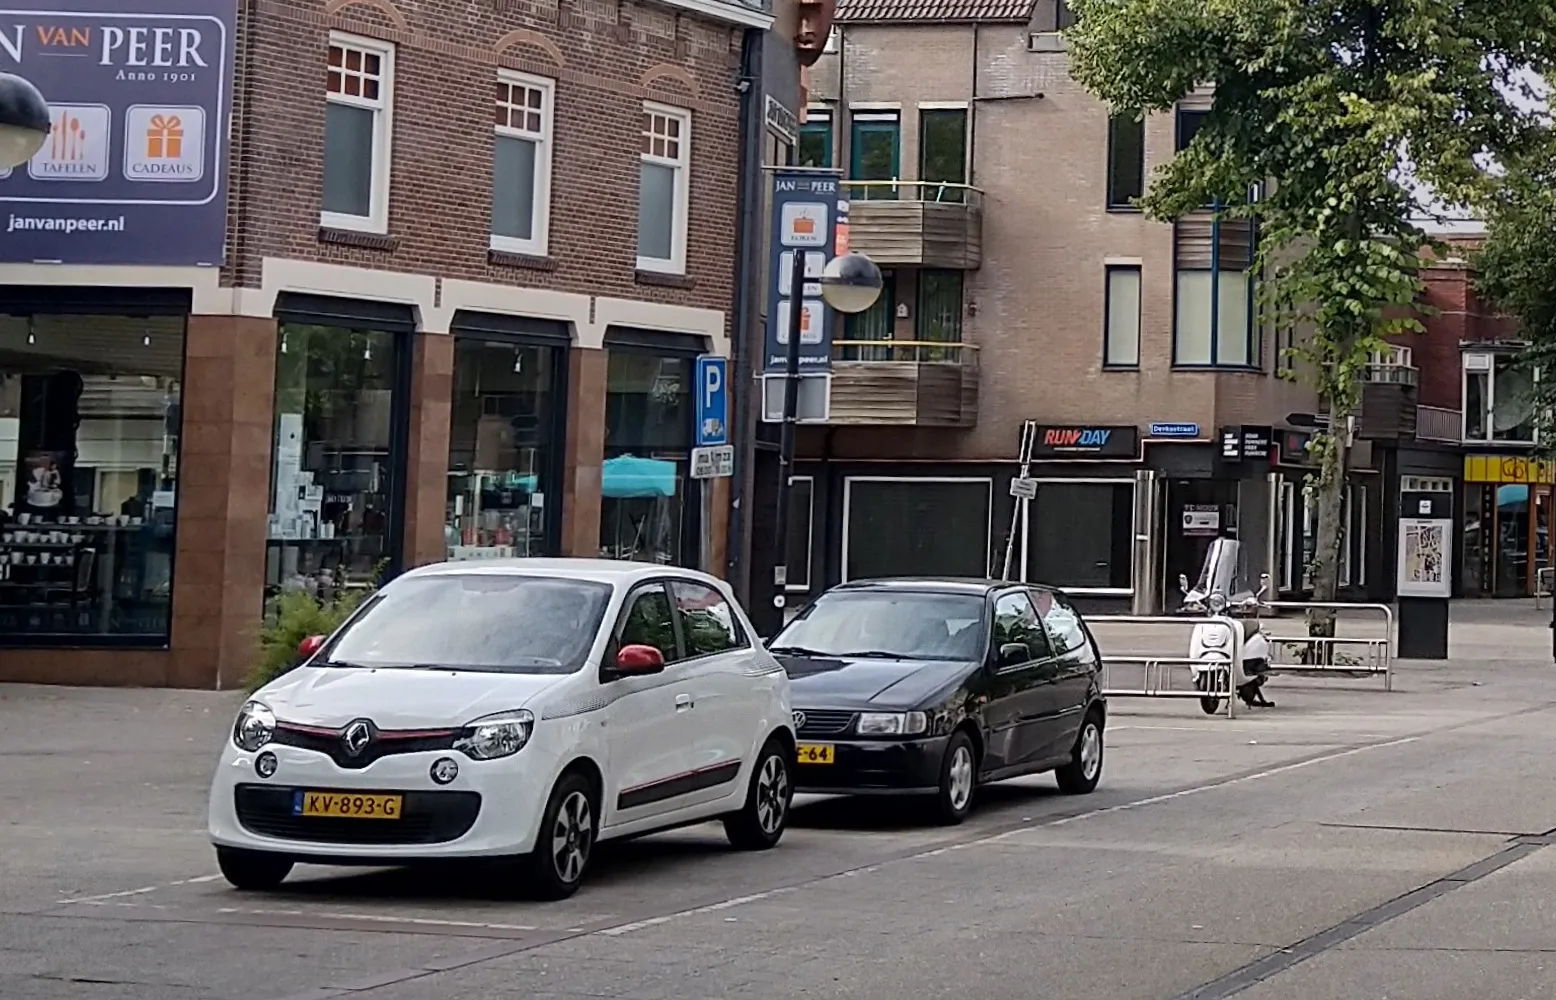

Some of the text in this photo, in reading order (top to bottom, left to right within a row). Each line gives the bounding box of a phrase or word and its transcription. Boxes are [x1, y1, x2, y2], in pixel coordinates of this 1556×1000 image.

[36, 25, 91, 47] VAN
[98, 26, 208, 68] PEER
[115, 70, 196, 83] Anno 1901
[41, 162, 97, 174] TAFELEN
[132, 162, 193, 174] CADEAUS
[776, 180, 796, 192] JAN
[811, 181, 836, 192] PEER
[7, 214, 125, 233] janvanpeer.nl
[705, 365, 721, 408] P
[309, 796, 395, 816] KV-893-G
